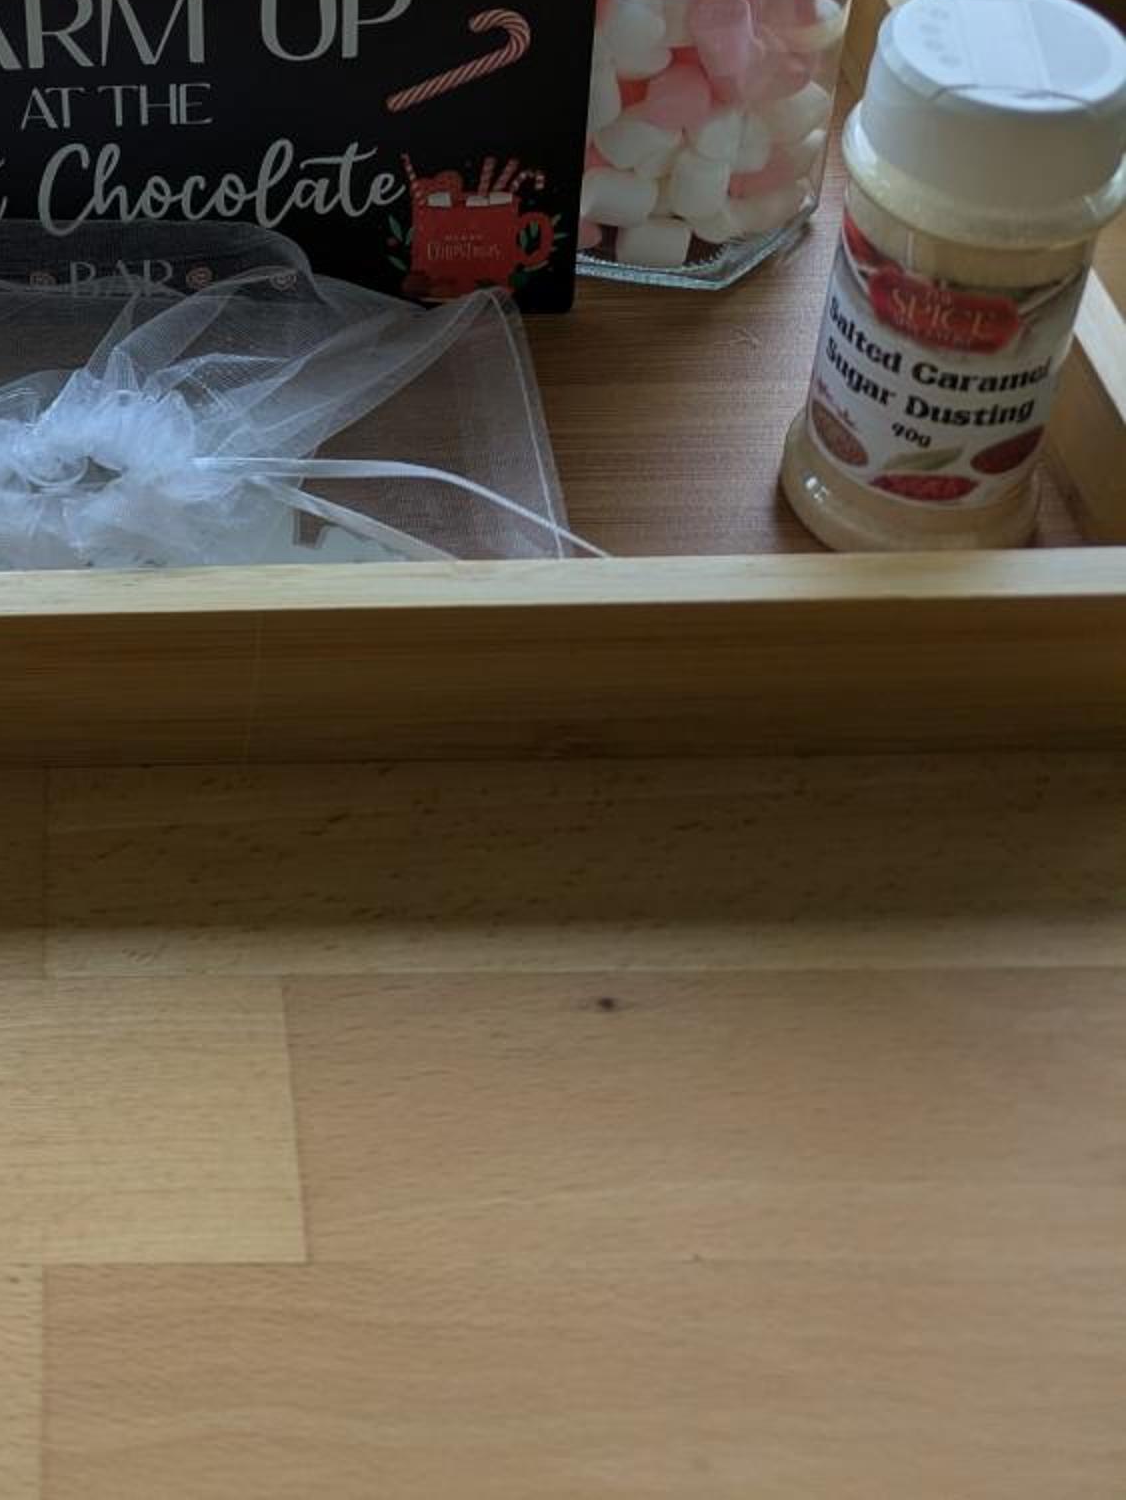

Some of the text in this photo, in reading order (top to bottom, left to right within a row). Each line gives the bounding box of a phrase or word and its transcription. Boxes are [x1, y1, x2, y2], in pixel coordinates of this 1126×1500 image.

[20, 82, 213, 131] AT THE
[36, 138, 407, 238] Chocolate
[828, 297, 903, 375] Salted
[826, 337, 1035, 427] Sugar Dusting
[891, 420, 932, 449] 90g
